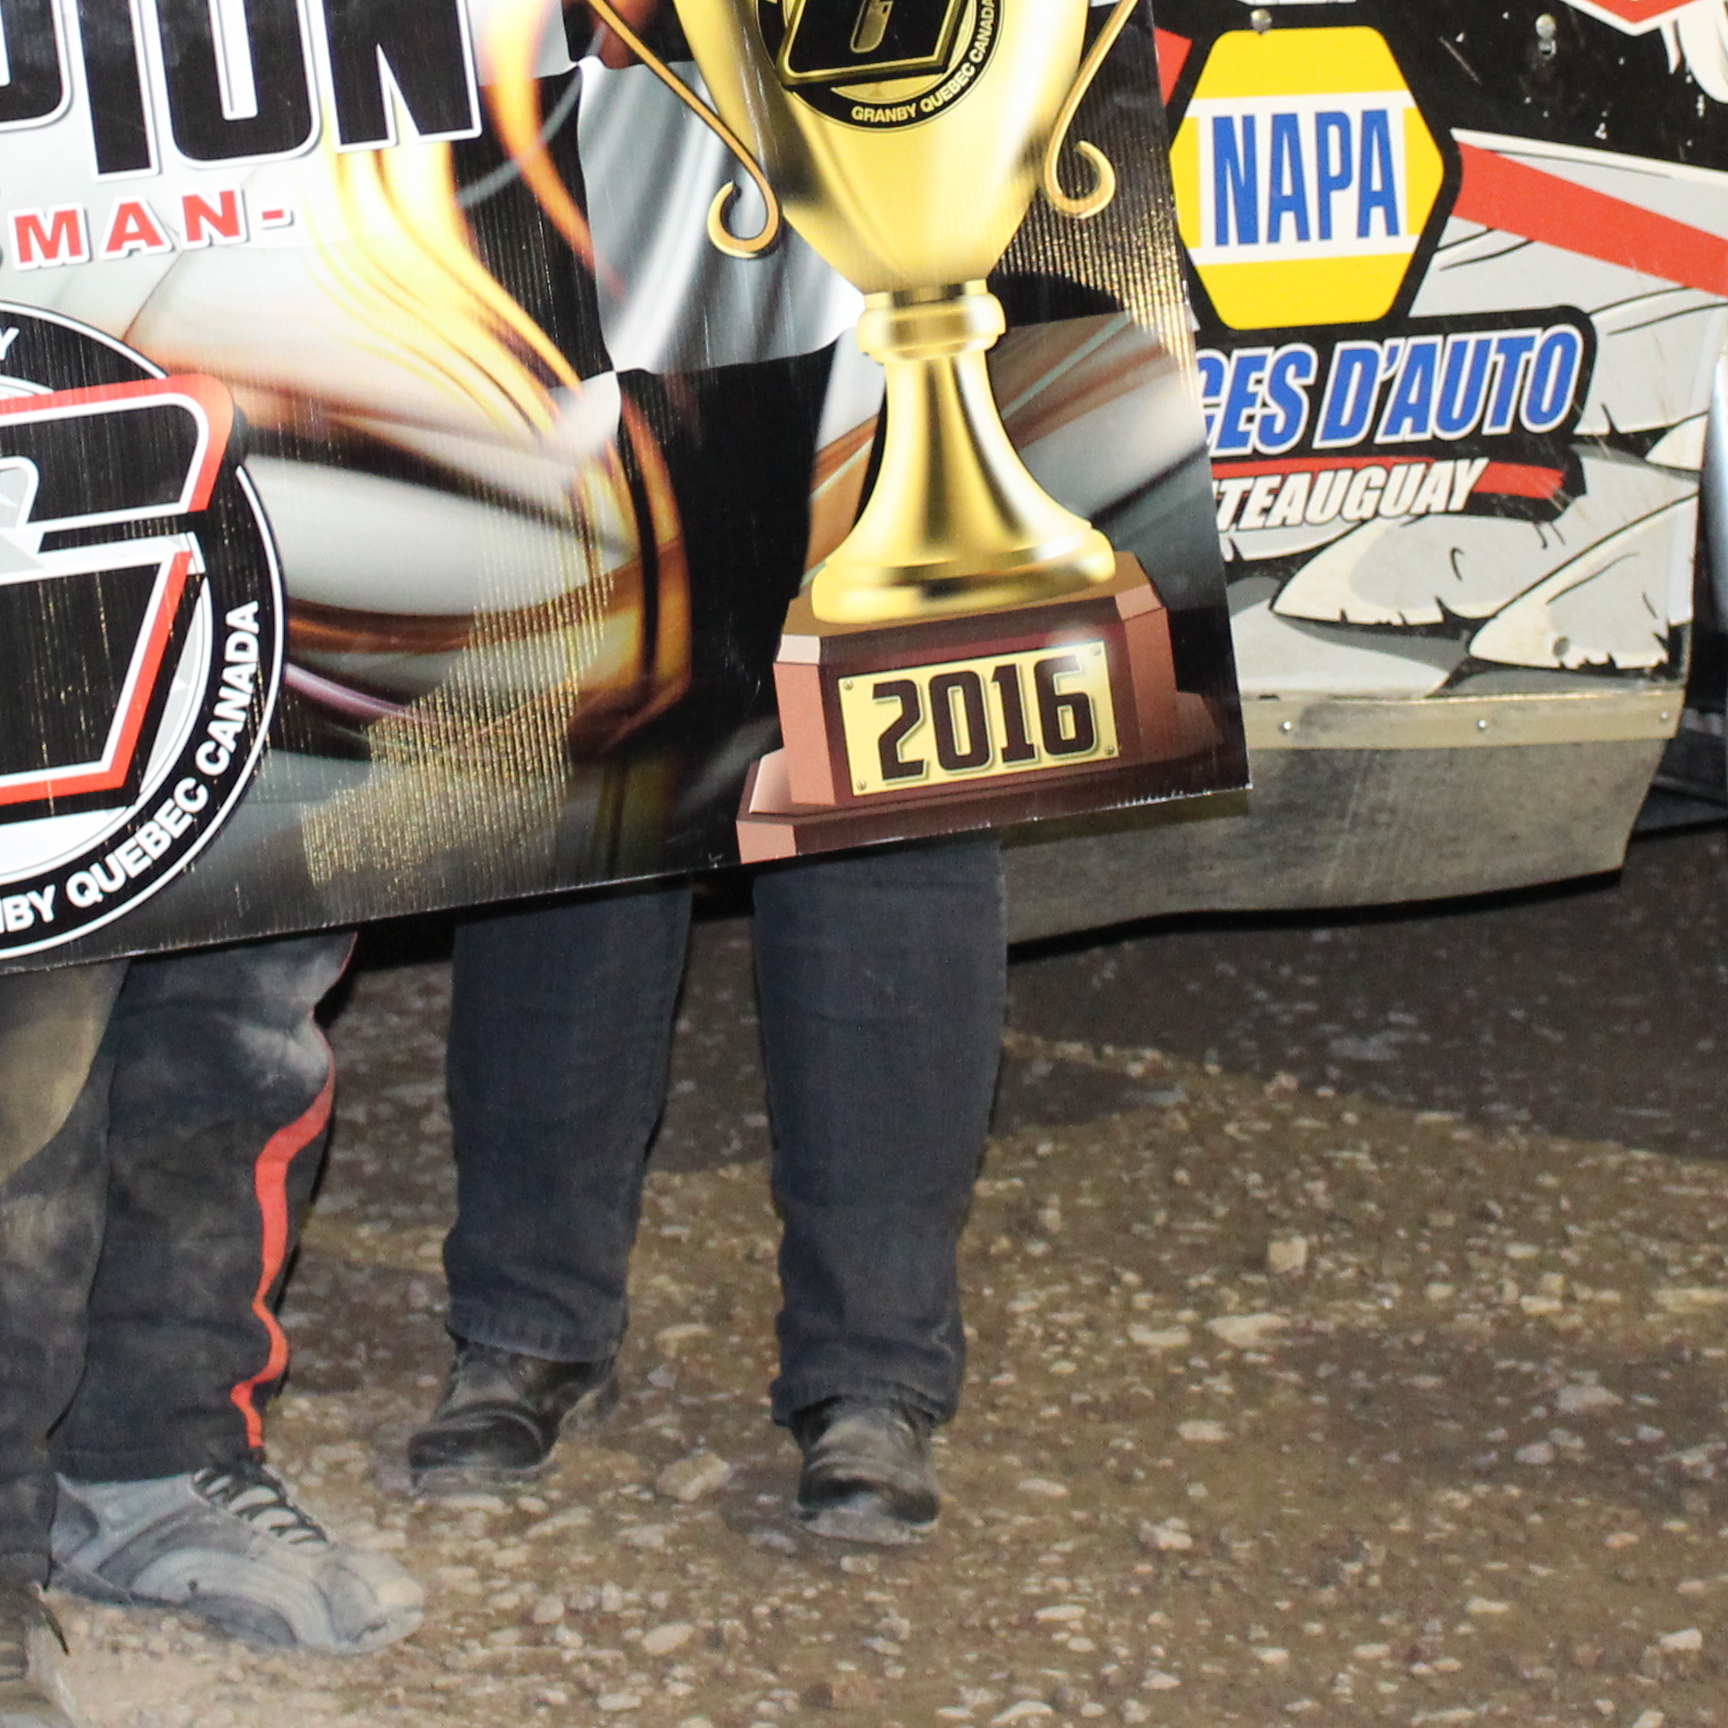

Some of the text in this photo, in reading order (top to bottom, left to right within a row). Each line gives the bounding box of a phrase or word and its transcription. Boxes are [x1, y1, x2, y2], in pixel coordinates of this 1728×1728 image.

[850, 101, 918, 123] GRANBY
[919, 62, 976, 114] QUEBEC
[1212, 107, 1400, 248] NAPA
[1312, 322, 1585, 450] D'AUTO
[1214, 457, 1490, 534] TEAUGUAY
[65, 777, 210, 908] QUEBEC
[194, 600, 260, 776] CANADA
[872, 655, 1097, 783] 2016
